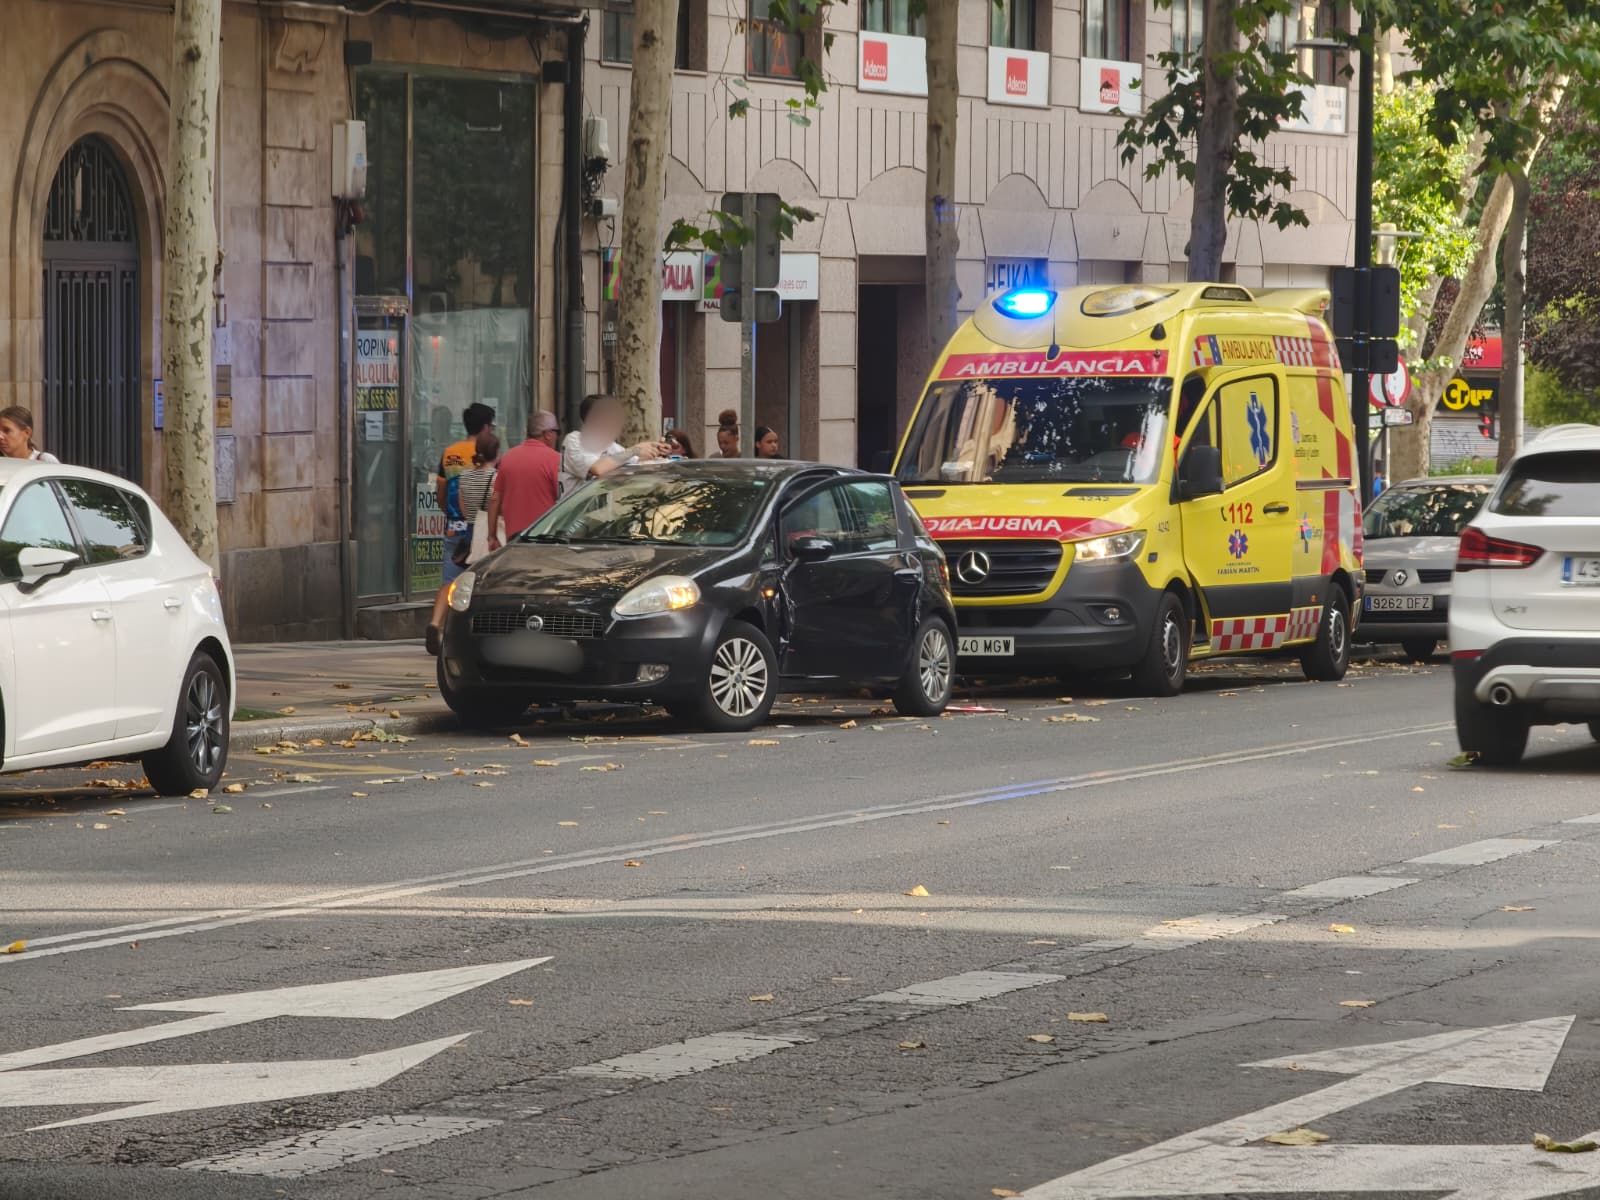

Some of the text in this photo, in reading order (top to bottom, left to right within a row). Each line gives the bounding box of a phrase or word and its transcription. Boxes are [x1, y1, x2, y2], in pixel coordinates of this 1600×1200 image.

[864, 60, 887, 76] Adecco
[1007, 75, 1027, 92] Adecco
[1221, 340, 1276, 360] AMBULANCIA
[356, 363, 398, 384] ALQUILA
[955, 359, 1145, 376] AMBULANCIA
[1229, 502, 1253, 524] 112
[1373, 597, 1429, 609] 9262 DFZ
[984, 639, 1010, 653] MGW
